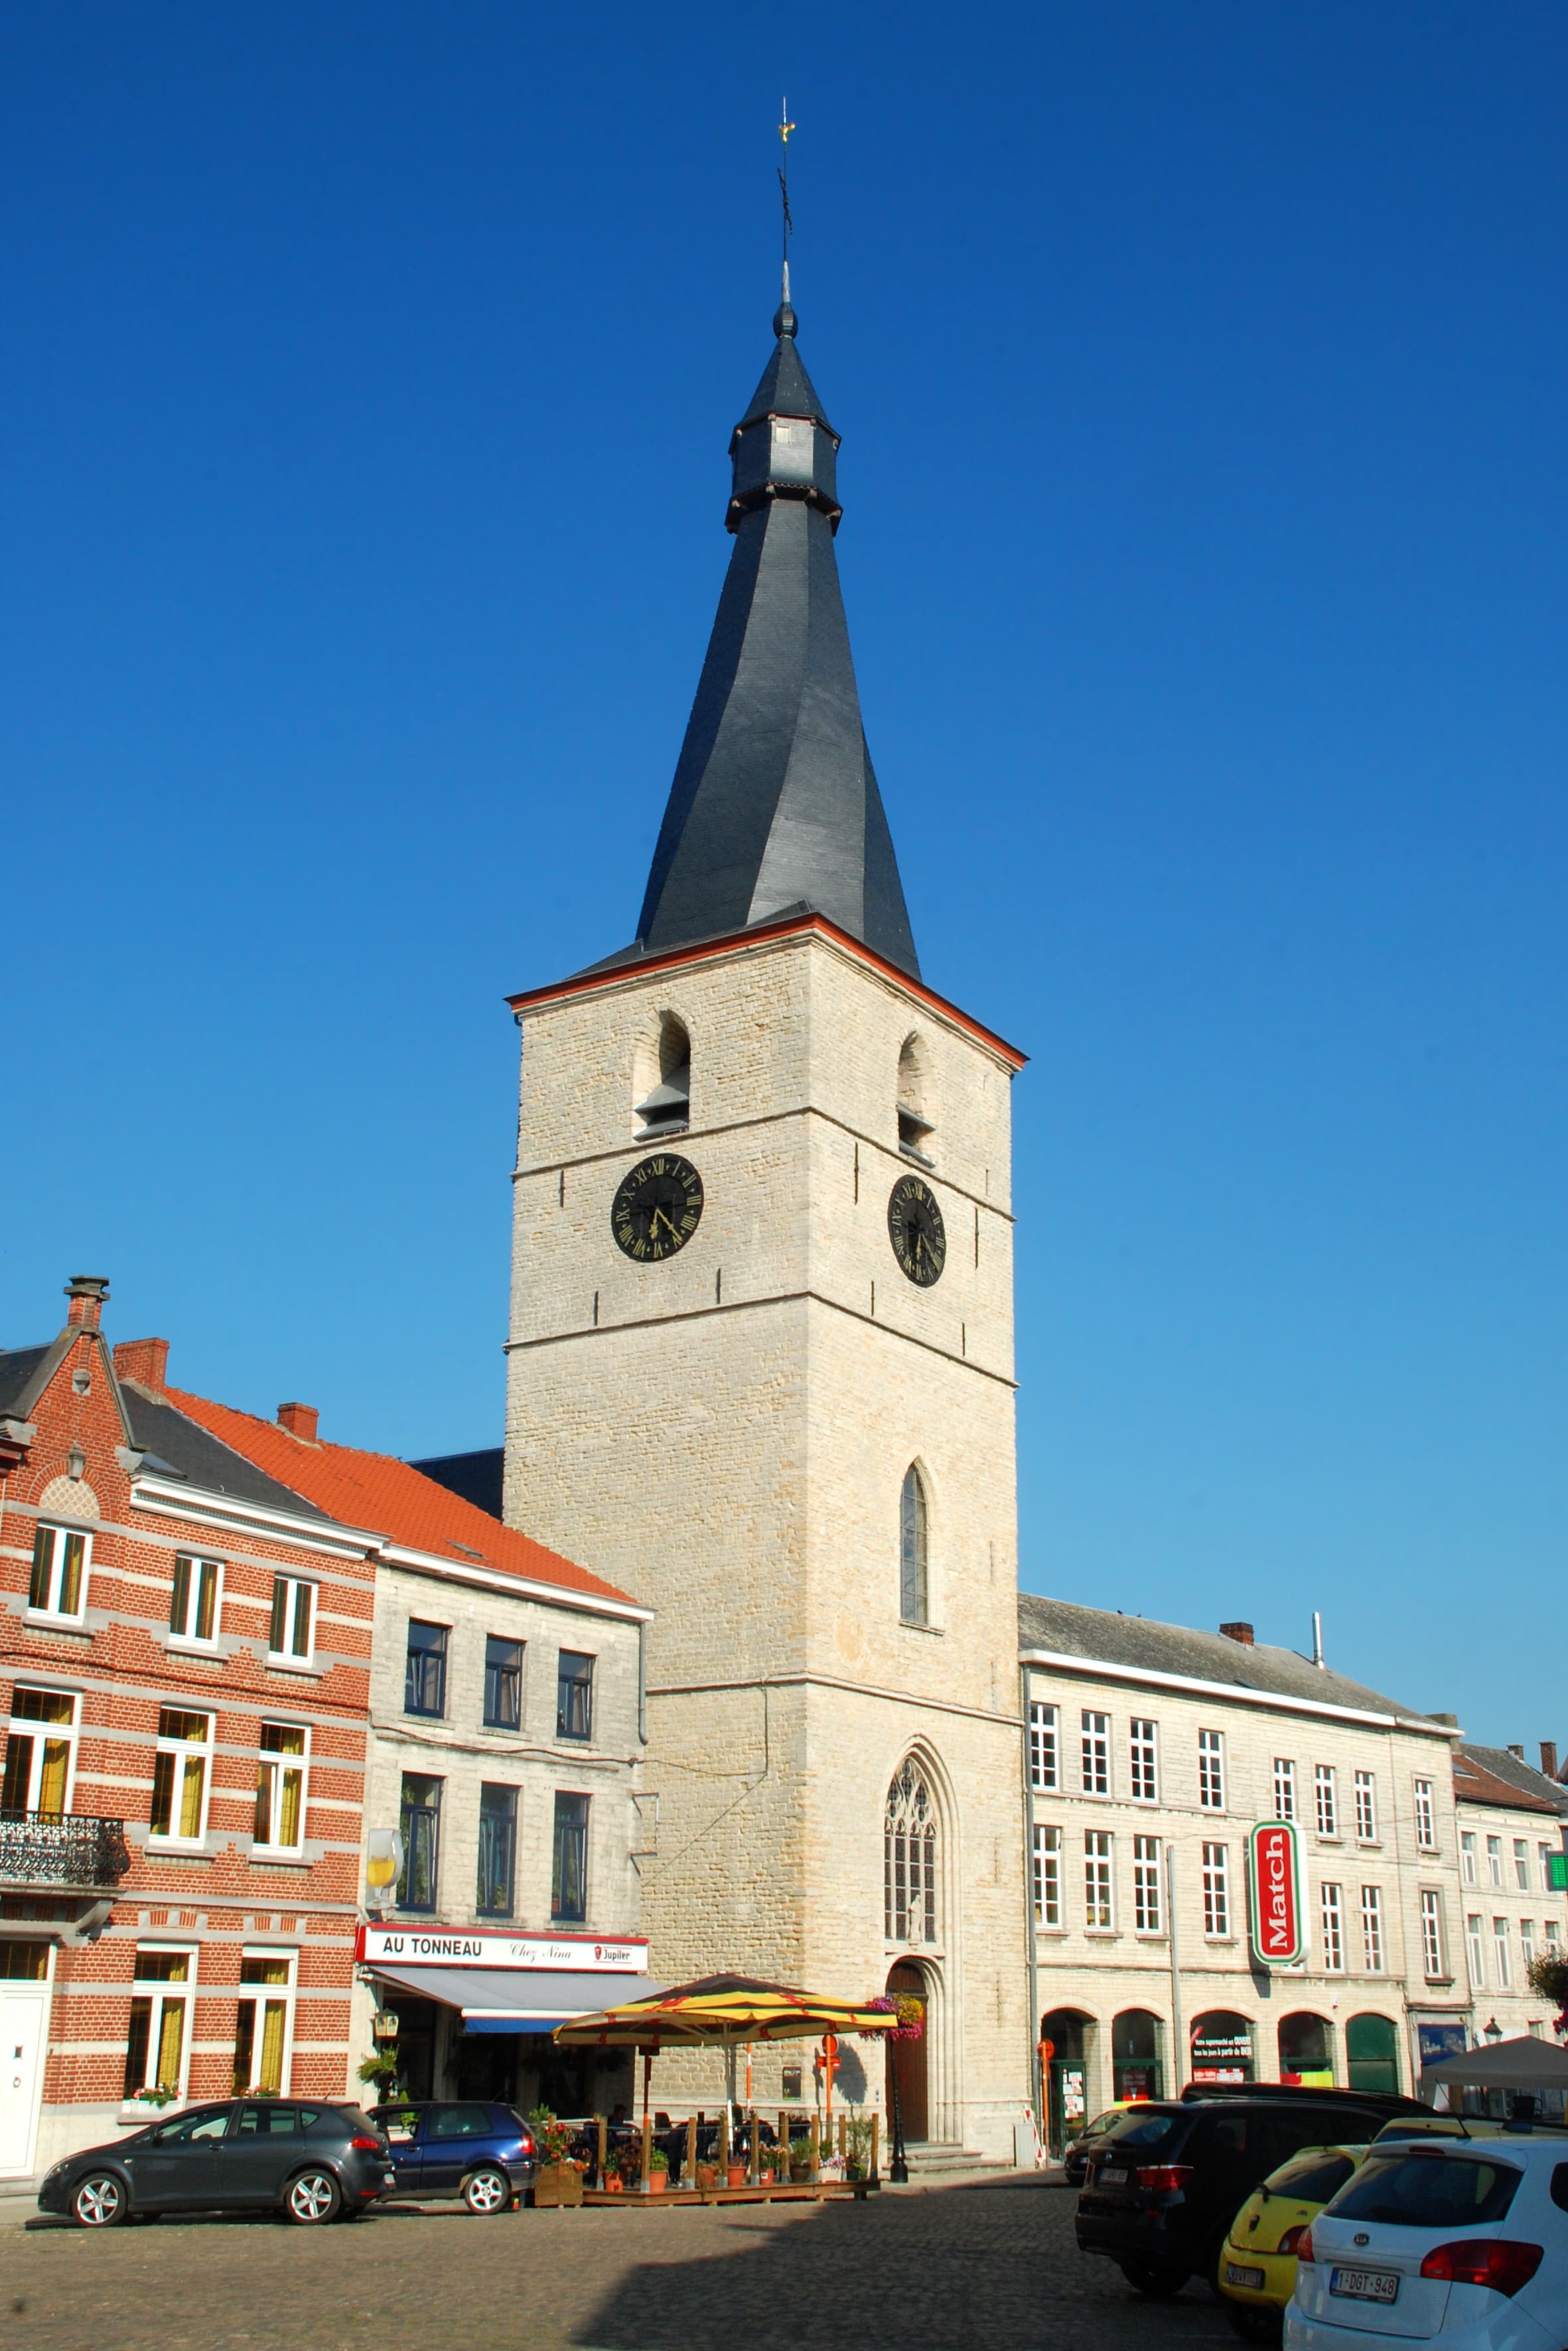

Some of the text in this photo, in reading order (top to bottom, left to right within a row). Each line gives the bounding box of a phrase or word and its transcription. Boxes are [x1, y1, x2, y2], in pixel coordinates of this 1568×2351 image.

[652, 1159, 664, 1176] XII
[682, 1174, 697, 1188] II
[687, 1195, 701, 1206] III
[1266, 1833, 1288, 1948] Match
[384, 1937, 482, 1956] AU TONNEAU
[510, 1943, 571, 1962] Chez Nina
[604, 1950, 630, 1960] Jupiler
[1339, 2273, 1395, 2294] 1-DGT-948
